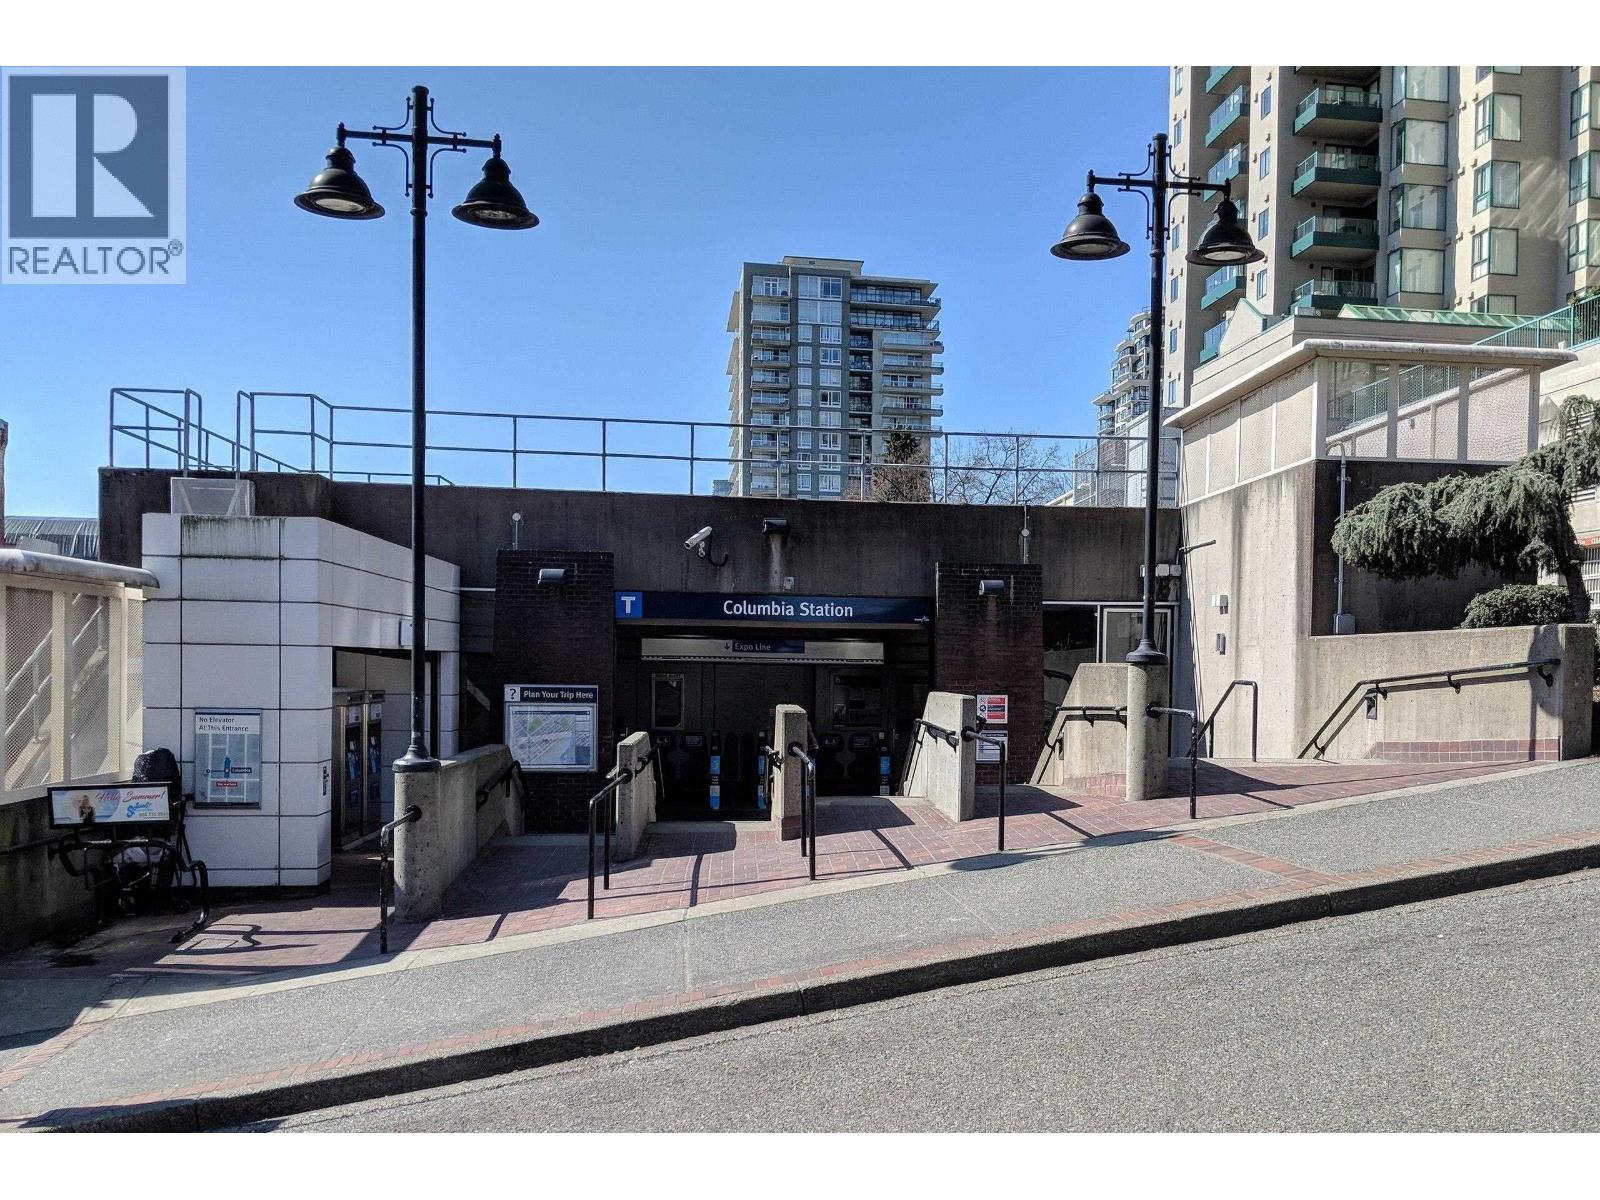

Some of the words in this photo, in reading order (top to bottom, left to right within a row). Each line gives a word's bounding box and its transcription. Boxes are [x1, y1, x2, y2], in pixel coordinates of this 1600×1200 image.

[621, 596, 636, 614] T
[723, 600, 795, 616] Columbia
[799, 602, 854, 617] Station
[734, 642, 753, 652] Expo
[755, 642, 772, 651] Line
[523, 690, 540, 698] Plan
[541, 690, 558, 699] Your
[560, 691, 574, 700] Trip
[575, 691, 594, 699] Here
